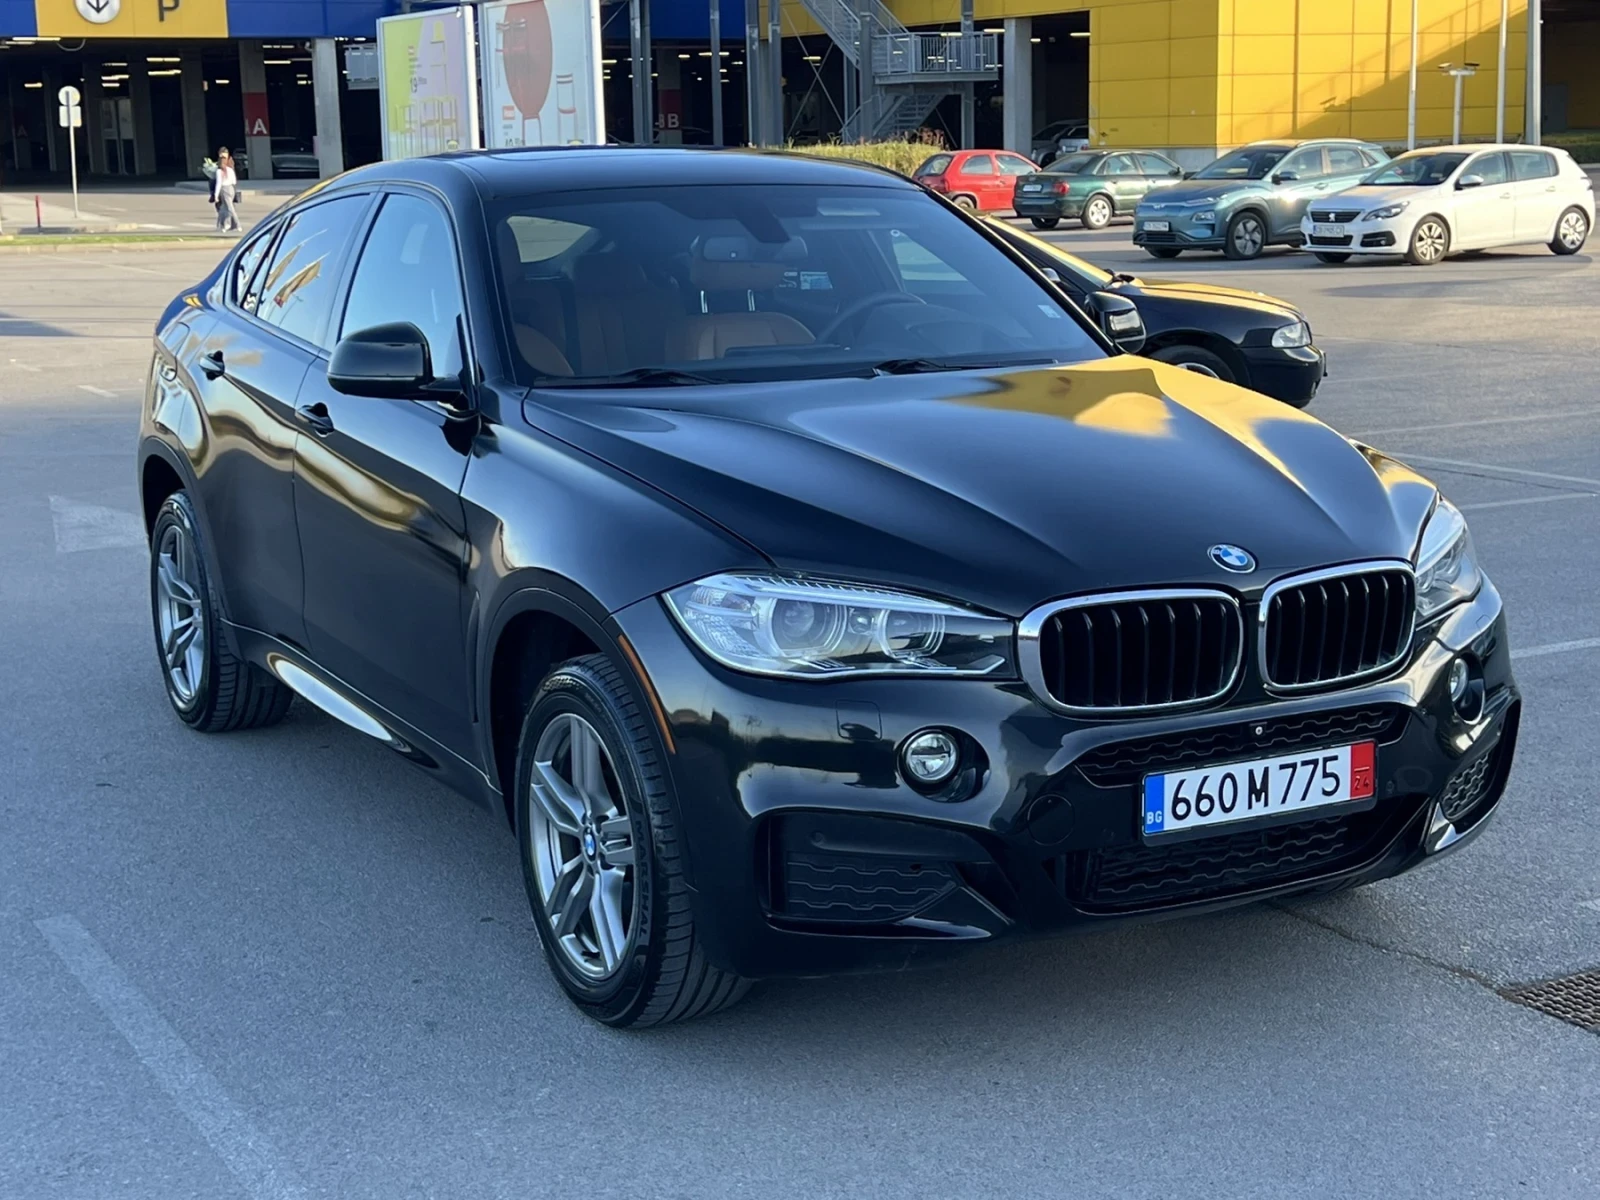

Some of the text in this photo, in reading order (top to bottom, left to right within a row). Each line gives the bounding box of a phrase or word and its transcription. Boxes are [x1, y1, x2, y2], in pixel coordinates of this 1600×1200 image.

[158, 0, 180, 22] P
[252, 118, 268, 135] A
[667, 113, 679, 128] B
[1146, 755, 1340, 825] BG 660 M 775
[1354, 775, 1370, 791] 24
[634, 820, 649, 938] MARSHAL
